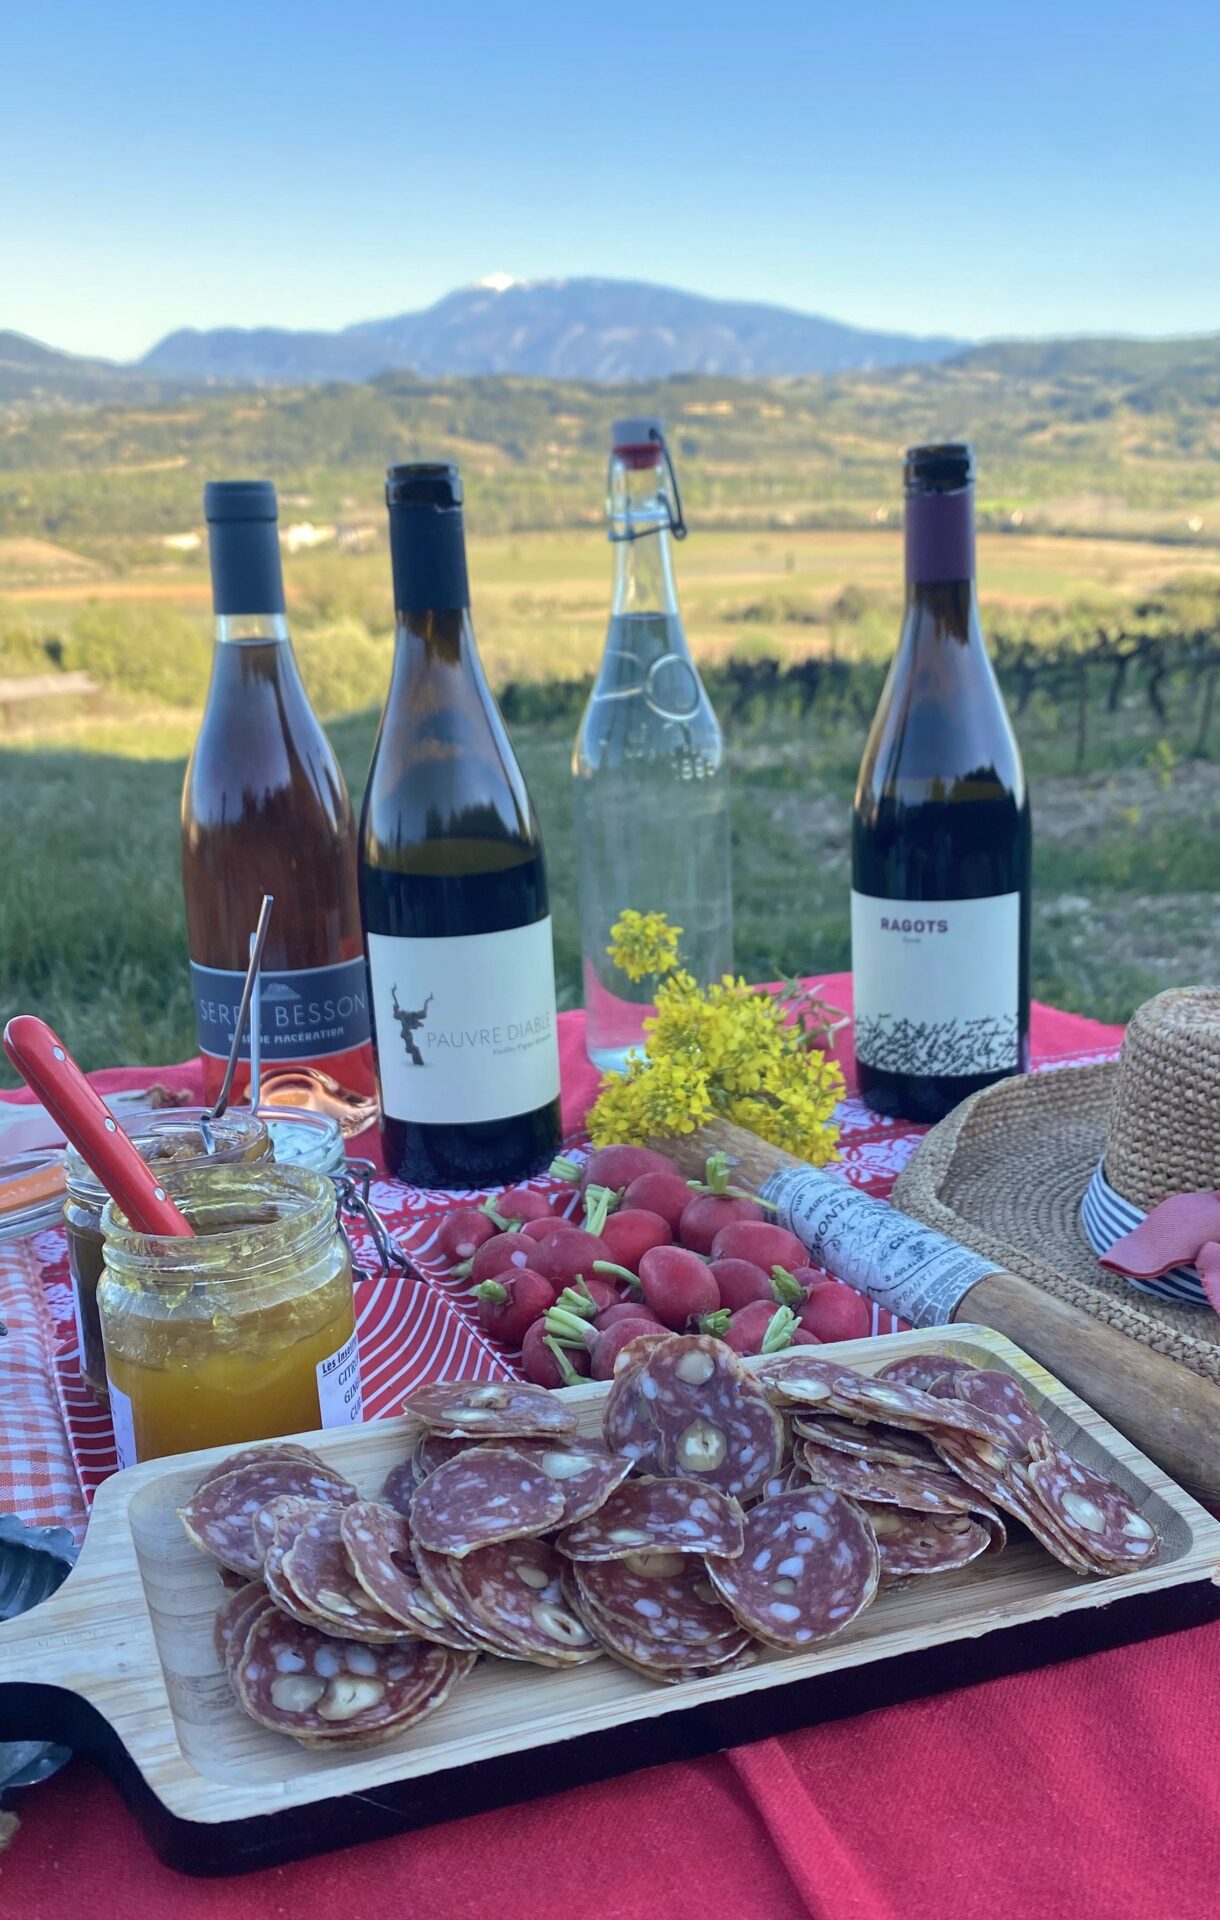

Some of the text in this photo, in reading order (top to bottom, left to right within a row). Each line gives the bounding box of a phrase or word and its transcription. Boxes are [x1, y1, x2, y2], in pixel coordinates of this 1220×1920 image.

[880, 917, 949, 933] RAGOTS
[275, 990, 366, 1028] BESSON
[274, 1026, 345, 1044] MACÉRATION
[427, 1026, 502, 1049] PAUVRE
[321, 1359, 336, 1374] Les
